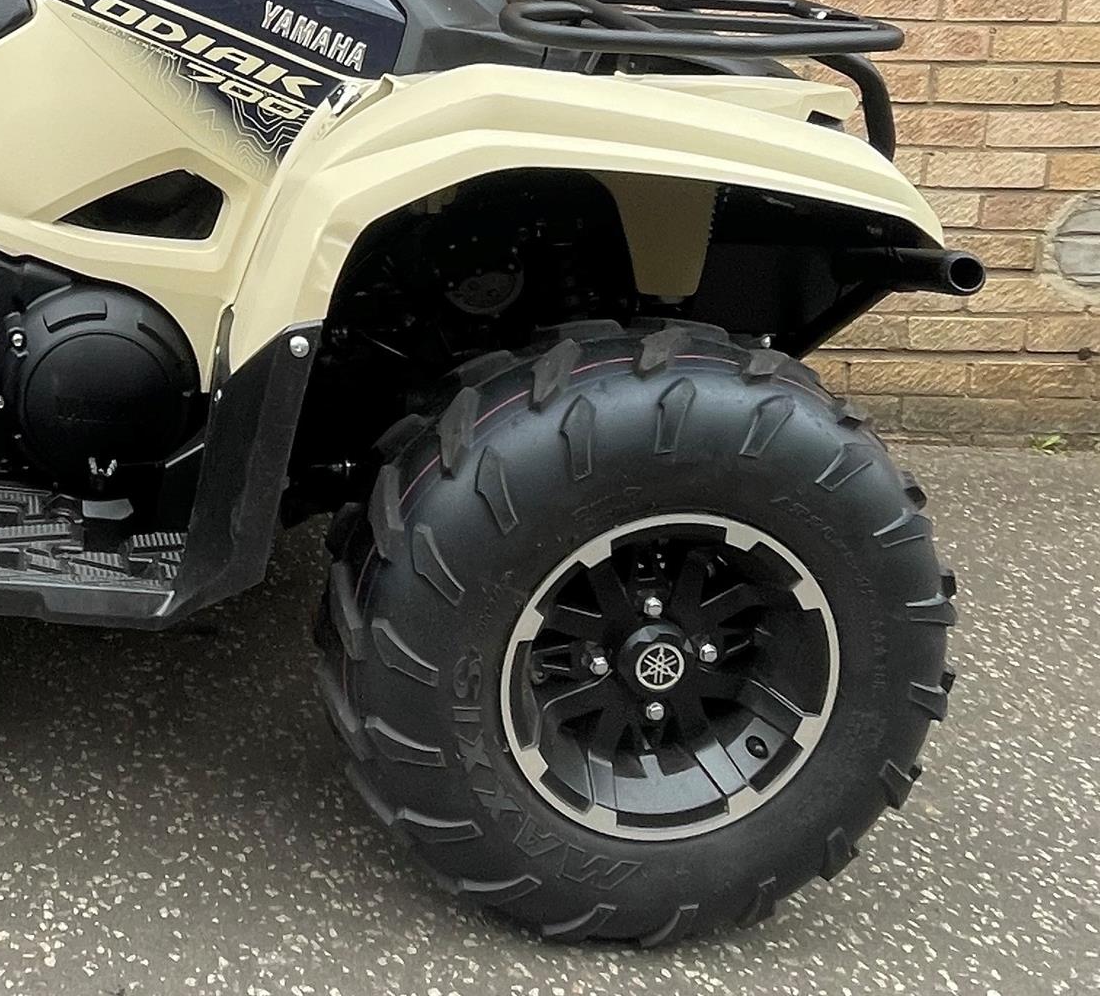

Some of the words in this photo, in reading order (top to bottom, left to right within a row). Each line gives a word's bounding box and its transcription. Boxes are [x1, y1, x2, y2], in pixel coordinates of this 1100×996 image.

[261, 0, 368, 72] YAMAHA
[186, 61, 305, 120] 700
[452, 652, 644, 891] MAXXIS
